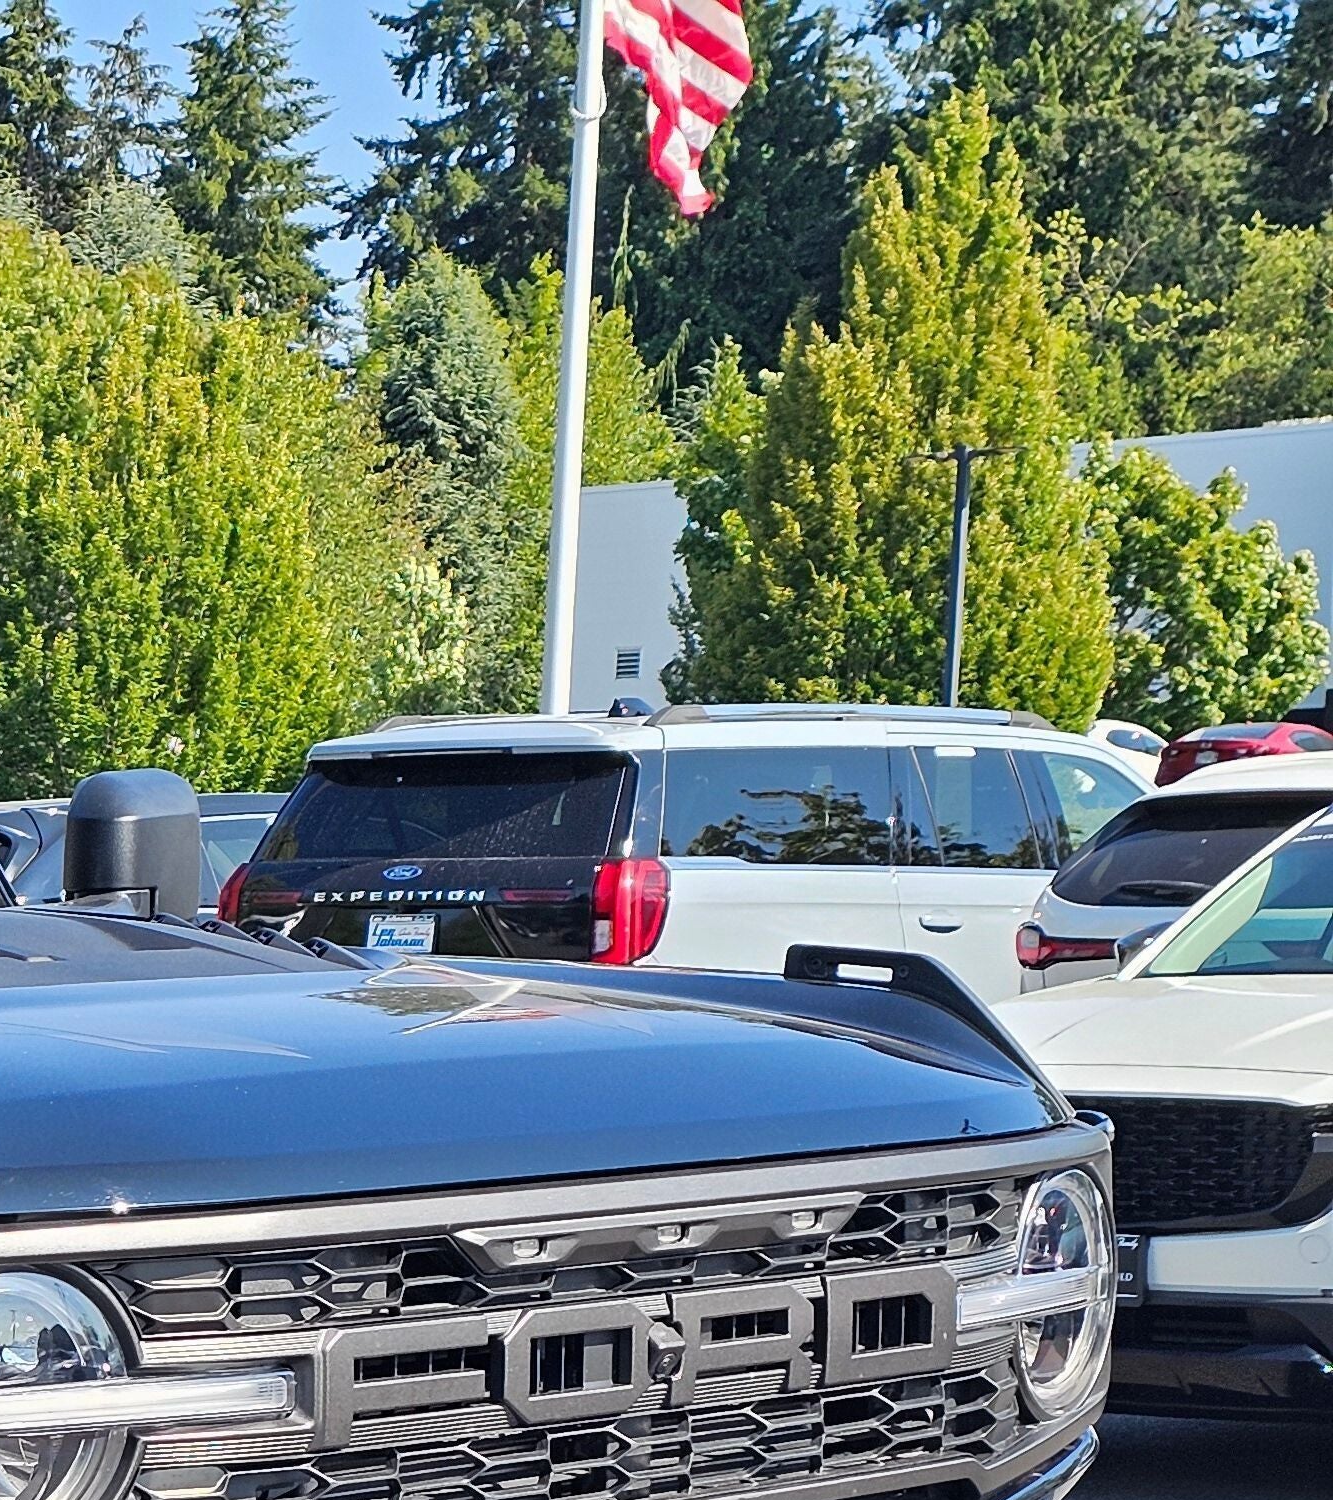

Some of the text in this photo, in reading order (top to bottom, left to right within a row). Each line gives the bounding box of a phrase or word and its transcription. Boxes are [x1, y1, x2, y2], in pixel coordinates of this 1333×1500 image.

[313, 890, 486, 902] EXPEDITION
[372, 923, 396, 937] Lee
[372, 937, 425, 947] Johnson
[311, 1261, 957, 1452] FORD
